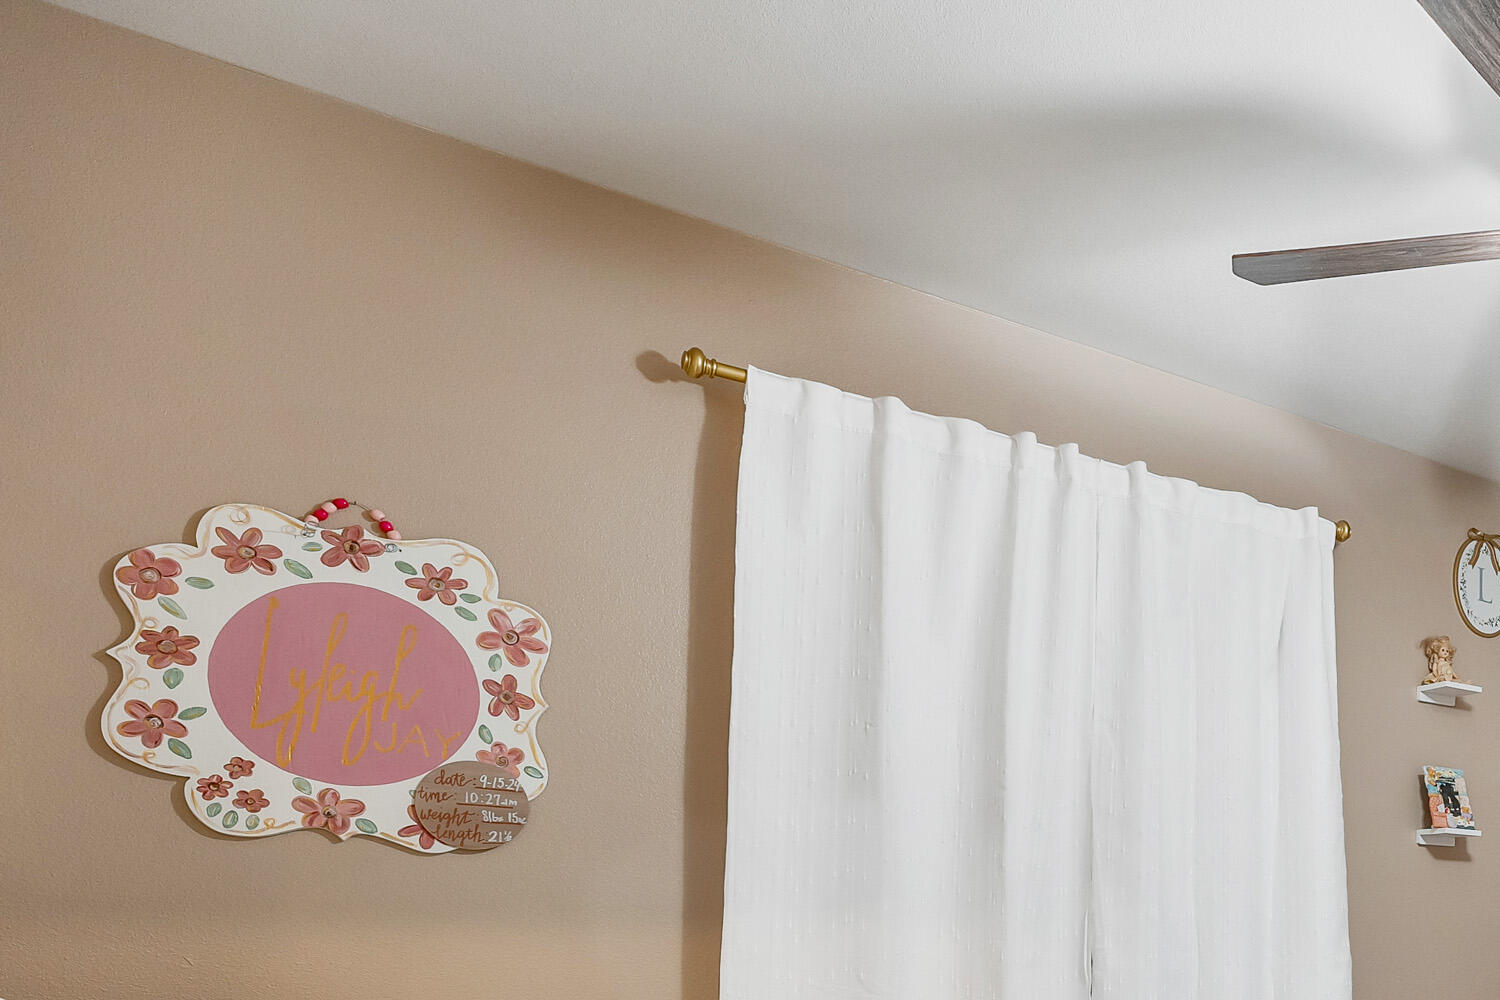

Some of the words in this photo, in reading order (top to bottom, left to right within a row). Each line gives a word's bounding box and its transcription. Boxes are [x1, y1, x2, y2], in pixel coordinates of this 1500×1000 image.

[1478, 566, 1493, 604] L
[250, 596, 424, 767] Lyleigh
[374, 722, 463, 759] JAY
